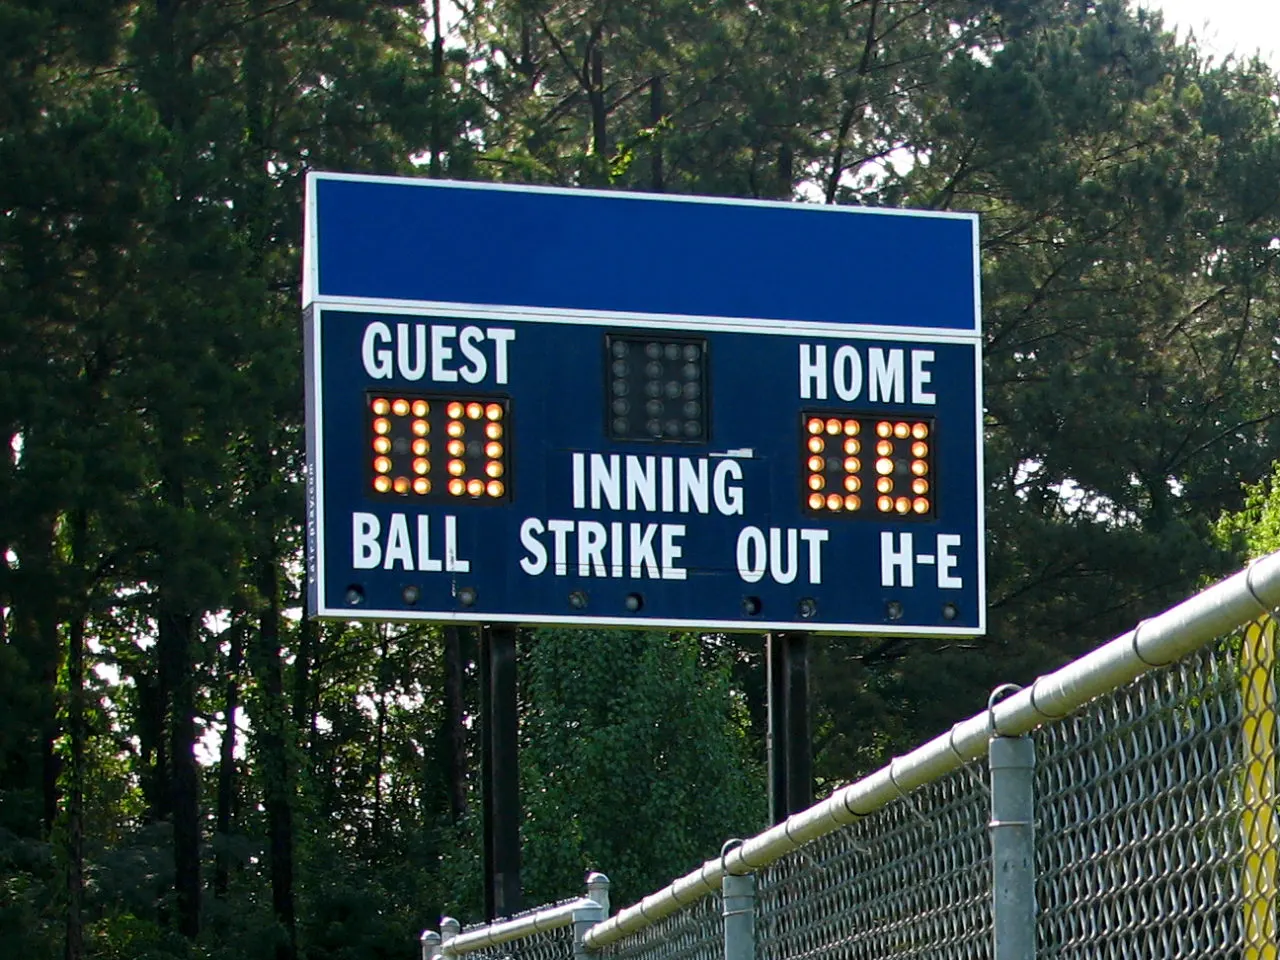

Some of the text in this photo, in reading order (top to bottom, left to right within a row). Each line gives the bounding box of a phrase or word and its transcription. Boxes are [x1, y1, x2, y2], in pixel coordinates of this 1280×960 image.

[361, 321, 516, 385] GUEST
[799, 343, 937, 405] HOME
[572, 452, 745, 516] INNING
[351, 511, 963, 589] BALL STRIKE OUT H-E
